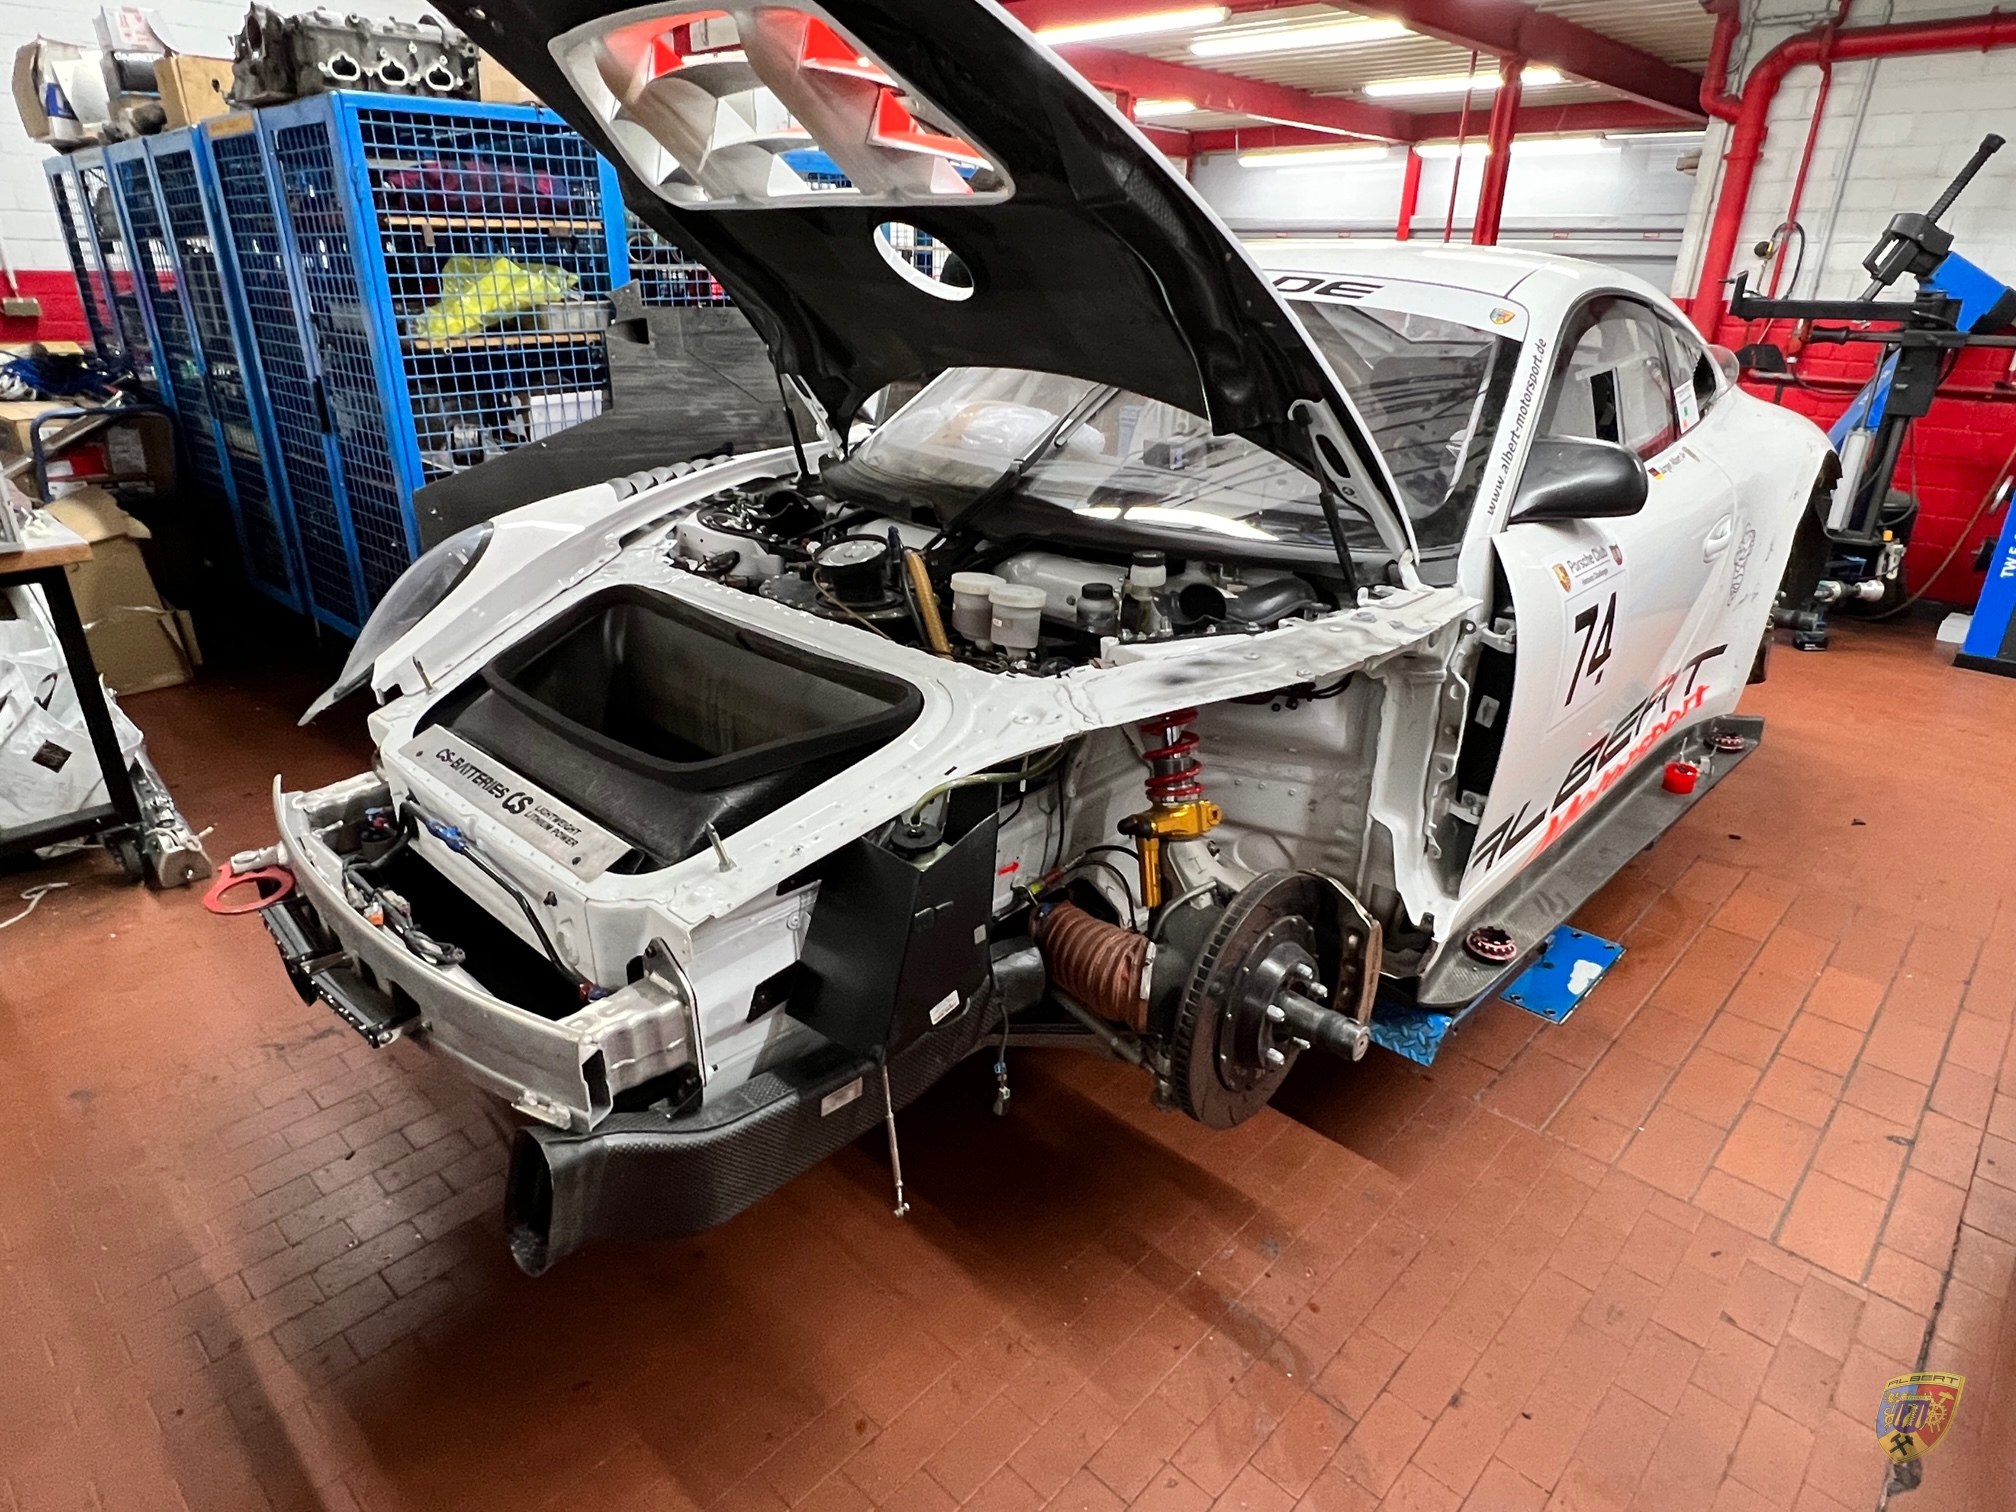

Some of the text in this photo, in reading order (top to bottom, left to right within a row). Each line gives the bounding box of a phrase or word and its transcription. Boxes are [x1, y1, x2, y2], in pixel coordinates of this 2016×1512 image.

[1487, 337, 1548, 517] www.albert-motorsport.de
[1566, 553, 1596, 574] Porsche
[1564, 591, 1617, 707] 74
[435, 748, 534, 815] CS-BATTERIES CS
[1471, 643, 1729, 873] ALBERT
[524, 811, 580, 848] LITHIUM POWER
[534, 804, 582, 836] LIGHTWEIGHT
